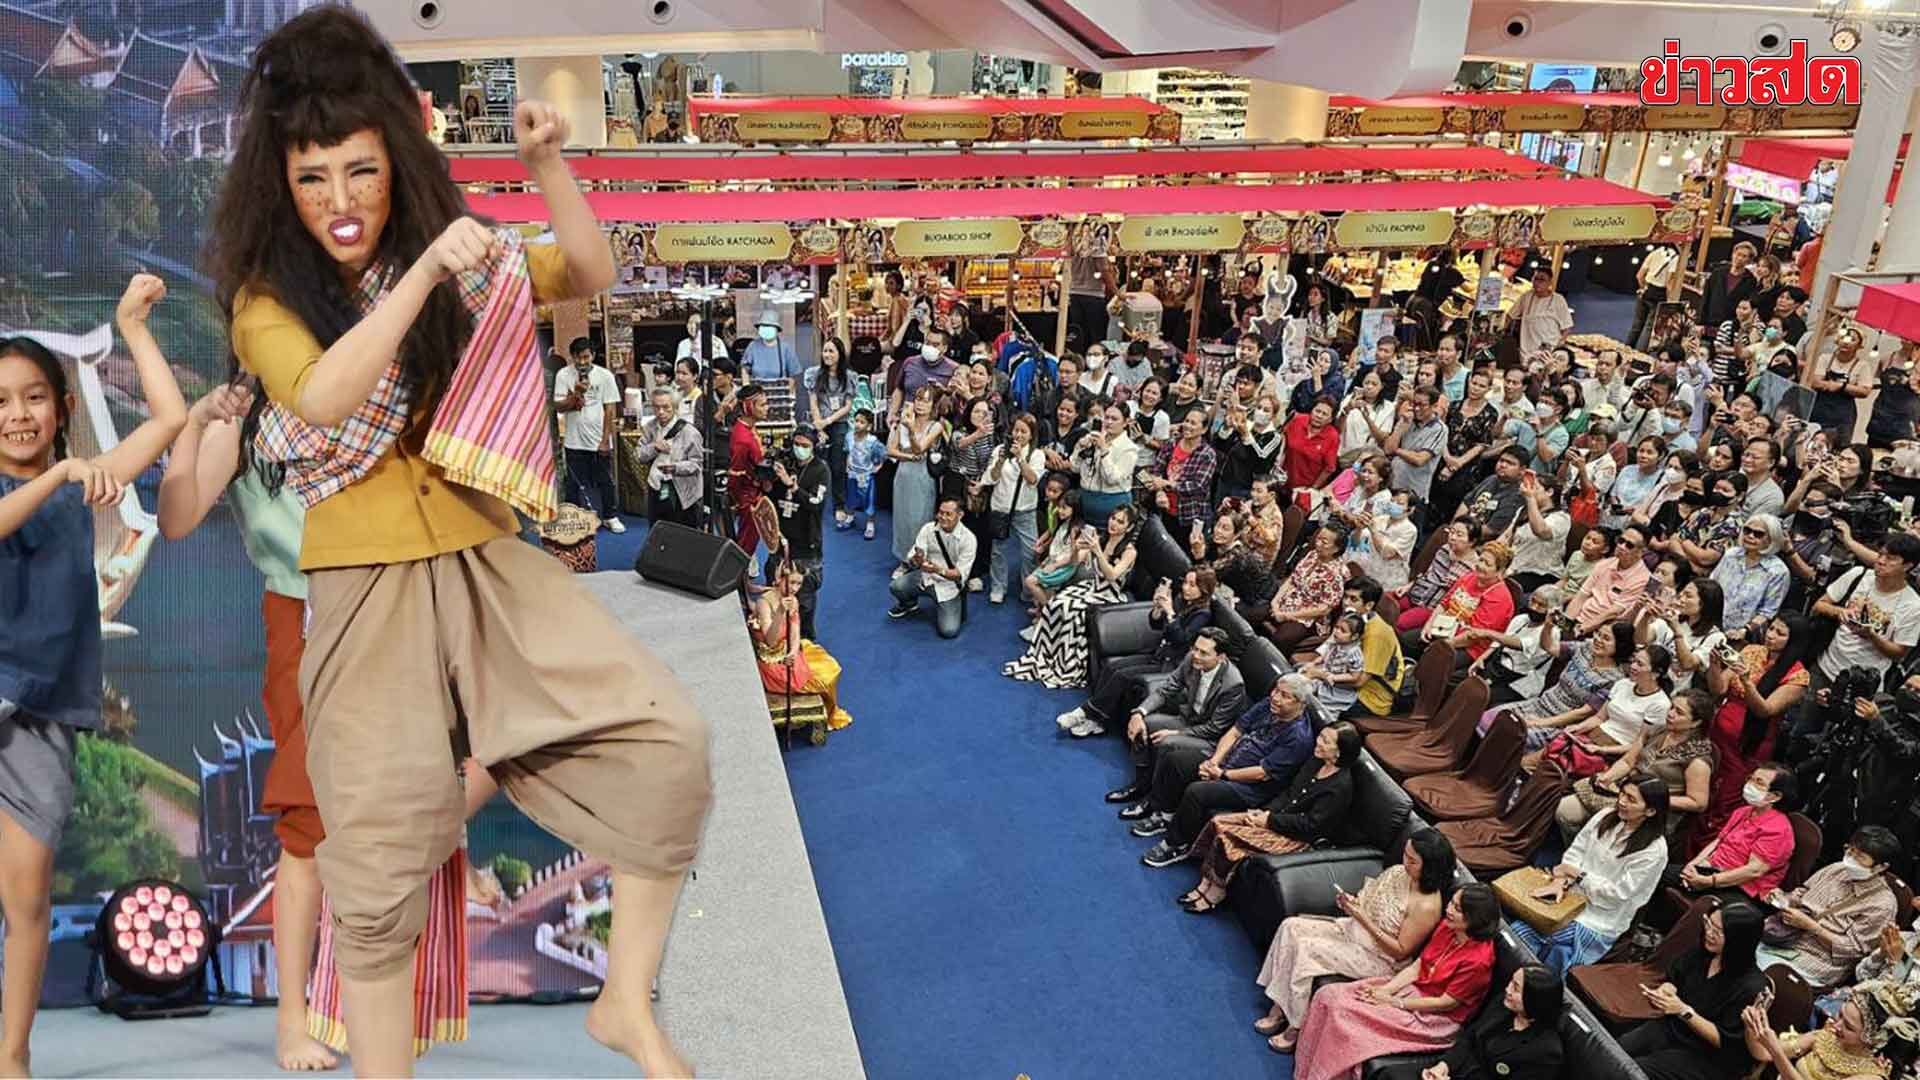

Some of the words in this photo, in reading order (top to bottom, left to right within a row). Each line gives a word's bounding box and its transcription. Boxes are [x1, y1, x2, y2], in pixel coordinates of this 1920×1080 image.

[841, 51, 908, 69] paradise
[727, 237, 776, 246] RATCHADA
[924, 233, 968, 242] BUGABOO
[969, 232, 992, 242] SHOP
